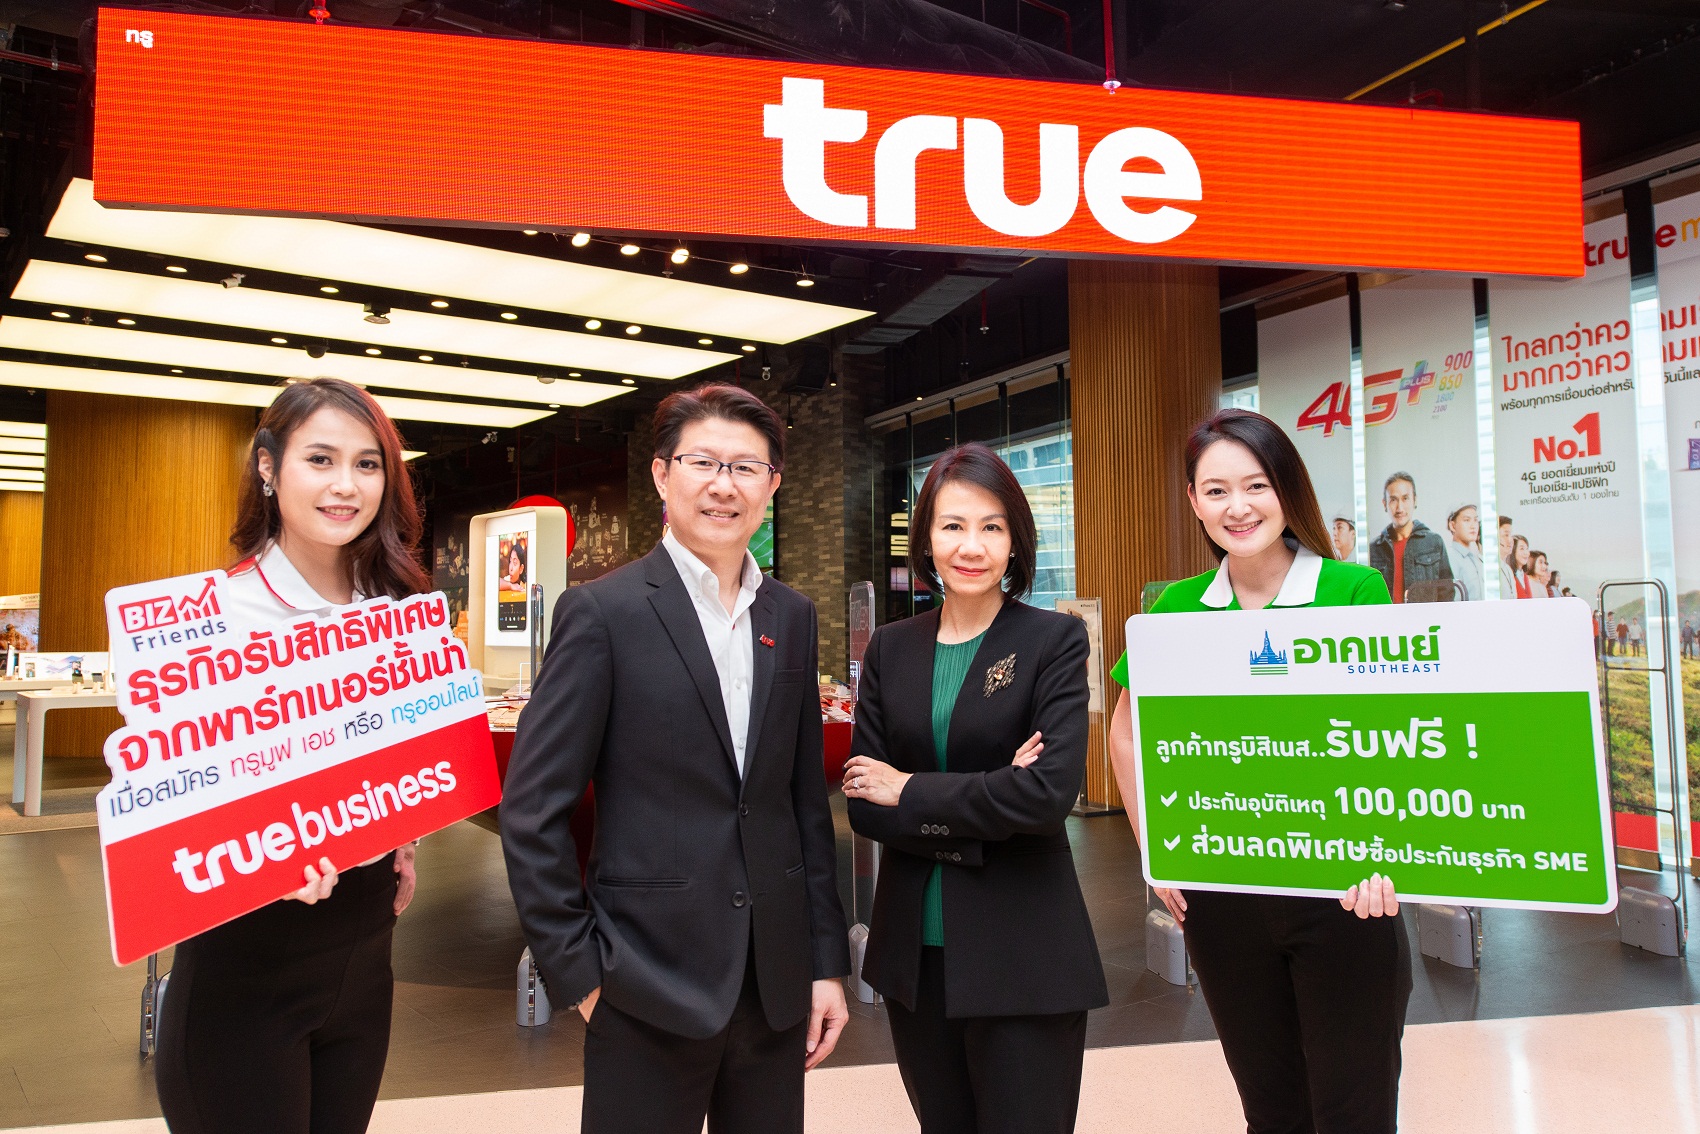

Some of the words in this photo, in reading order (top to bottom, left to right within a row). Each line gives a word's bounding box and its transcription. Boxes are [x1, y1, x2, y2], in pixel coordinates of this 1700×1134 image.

[763, 77, 1203, 243] true
[1444, 350, 1473, 373] 900
[1436, 392, 1455, 404] 1800
[1438, 373, 1463, 391] 850
[1533, 412, 1601, 463] No.1
[1521, 471, 1537, 482] 4G
[1541, 461, 1616, 480] ยอดเยี่ยมแห่งปี
[124, 599, 175, 632] BIZ
[131, 619, 227, 652] Friends
[1293, 625, 1441, 664] อาคเนย์
[128, 598, 446, 713] ธุรกิจรับสิทธิพิเศษ
[1347, 663, 1441, 674] SOUTHEAST
[118, 636, 467, 772] จากพาร์ทเนอร์ชั้นนำ
[110, 765, 220, 817] เมื่อสมัคร
[230, 737, 292, 777] ทรูมูฟ
[302, 727, 335, 754] เอช
[344, 711, 383, 740] หรือ
[391, 676, 480, 725] ทรูออนไลน์
[1188, 790, 1326, 820] ประกันอุบัติเหตุ
[1334, 786, 1473, 822] 100,000
[1482, 803, 1526, 819] บาท
[1533, 851, 1589, 872] SME
